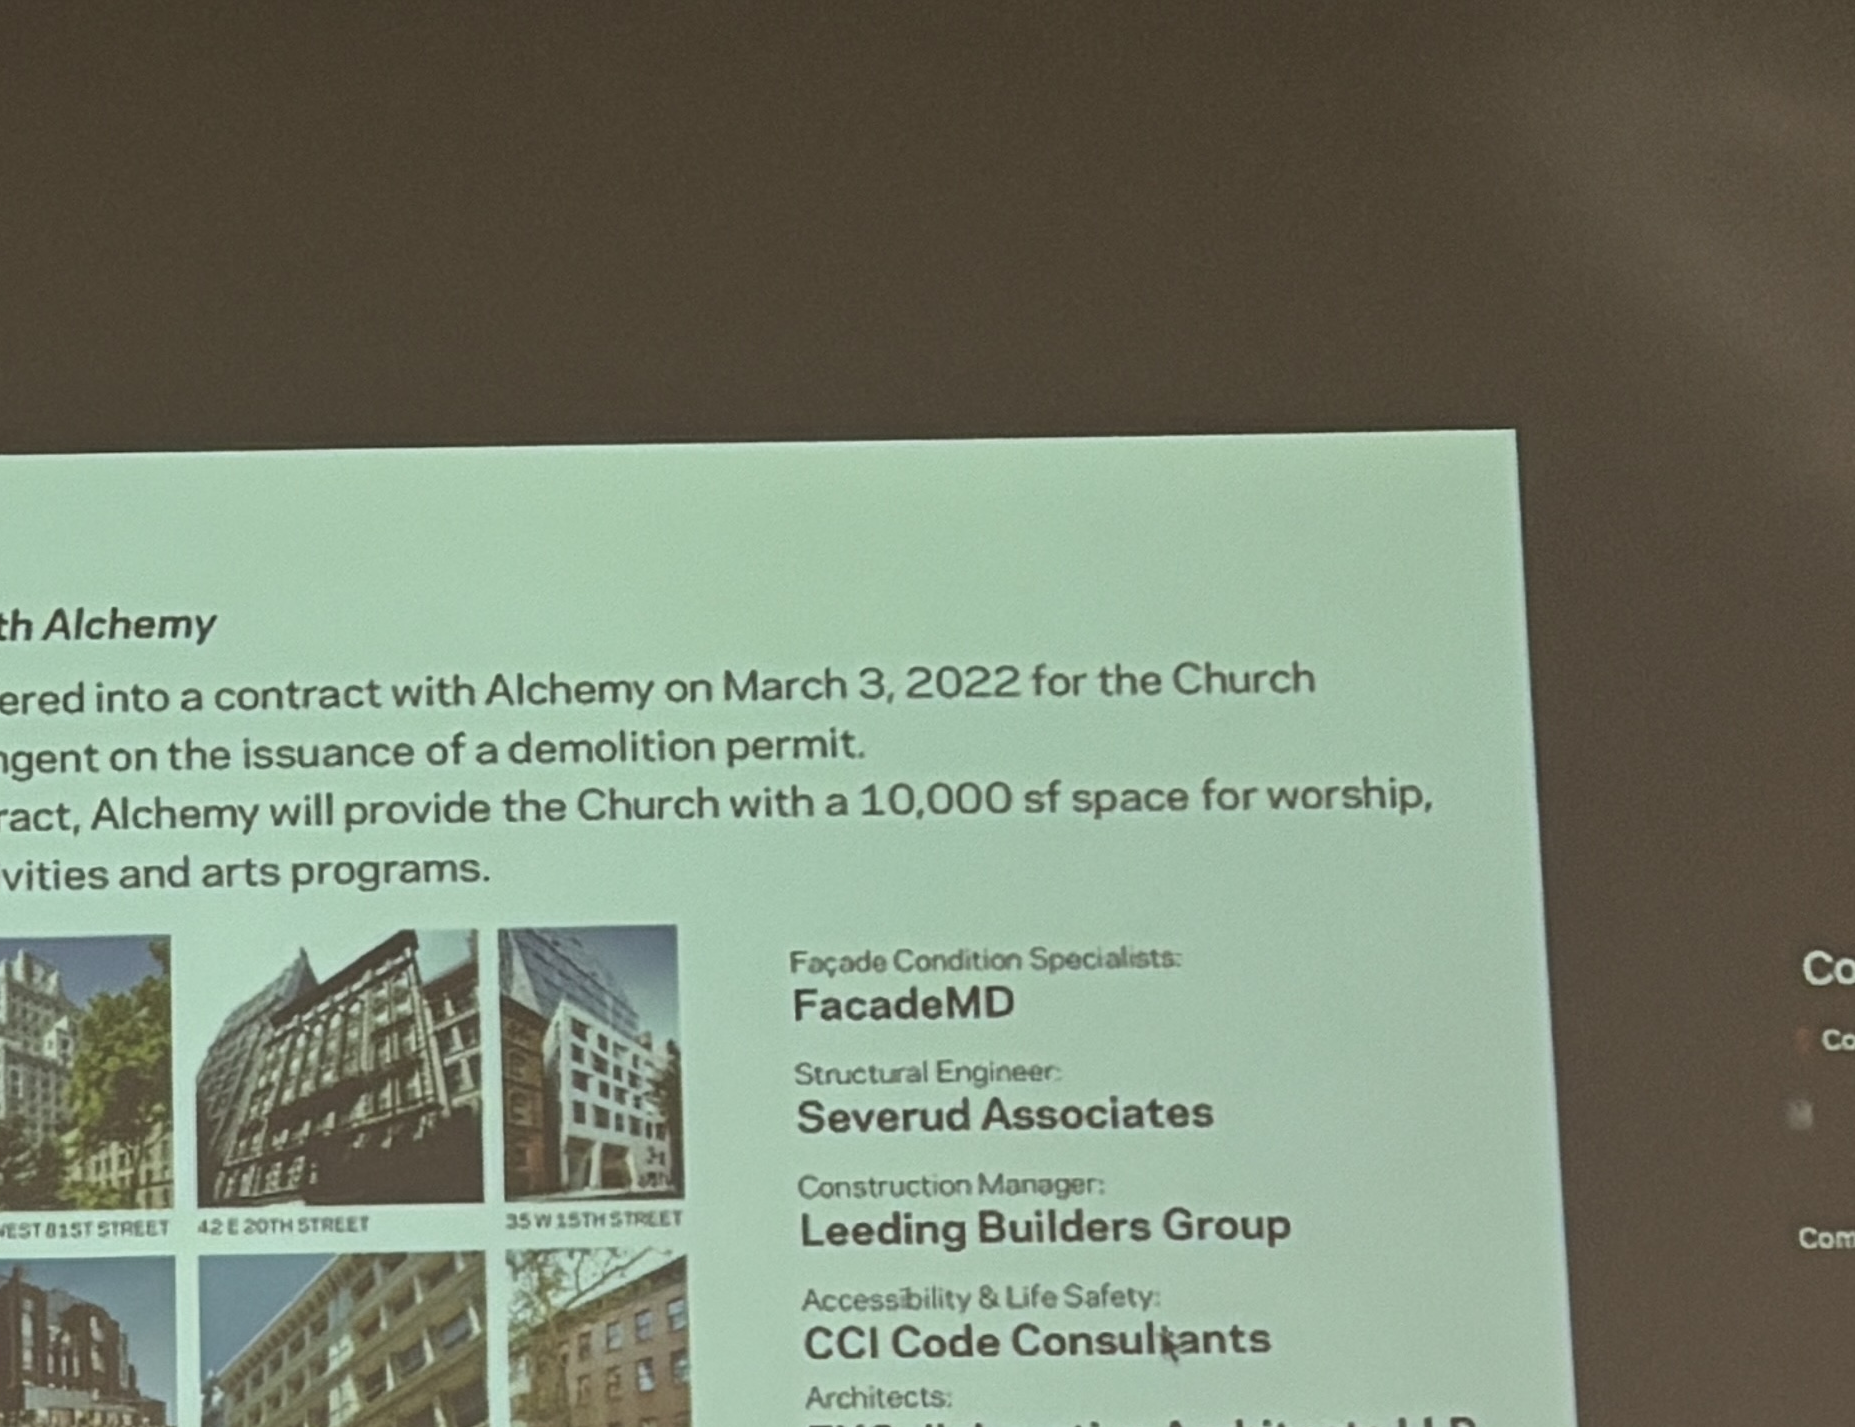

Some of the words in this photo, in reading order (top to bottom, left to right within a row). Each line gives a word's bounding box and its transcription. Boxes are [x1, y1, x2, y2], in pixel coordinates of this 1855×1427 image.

[40, 606, 218, 643] Alchemy
[95, 681, 171, 714] into
[180, 687, 204, 713] a
[214, 678, 383, 712] contract
[391, 673, 477, 708] with
[484, 671, 655, 711] Alchemy
[664, 678, 714, 704] on
[723, 666, 848, 702] March
[859, 666, 895, 705] 3,
[905, 664, 1022, 700] 2022
[1030, 662, 1088, 698] for
[1097, 662, 1162, 697] the
[1172, 660, 1316, 696] Church
[108, 747, 158, 773] on
[167, 736, 232, 771] the
[242, 737, 415, 770] issuance
[425, 730, 467, 767] of
[475, 741, 499, 766] a
[507, 728, 716, 765] demolition
[726, 726, 866, 767] permit.
[90, 795, 260, 836] Alchemy
[269, 791, 334, 827] will
[344, 789, 491, 834] provide
[501, 788, 567, 823] the
[576, 785, 720, 822] Church
[729, 784, 815, 819] with
[825, 793, 849, 817] a
[860, 781, 1013, 820] 10,000
[1023, 780, 1062, 814] sf
[1072, 787, 1190, 820] space
[1201, 777, 1259, 811] for
[1266, 775, 1433, 818] worship,
[118, 855, 191, 890] and
[201, 857, 282, 889] arts
[291, 859, 490, 894] programs.
[789, 948, 888, 979] Façade
[892, 948, 1023, 974] Condition
[793, 984, 1015, 1022] FacadeMD
[793, 1059, 929, 1086] Structural
[797, 1096, 971, 1134] Severud
[980, 1094, 1215, 1131] Associates
[797, 1173, 973, 1201] Construction
[977, 1172, 1106, 1201] Manager:
[97, 1219, 170, 1239] STREET
[197, 1217, 224, 1236] 42
[226, 1217, 239, 1236] E
[242, 1217, 294, 1236] 20TH
[297, 1215, 370, 1235] STREET
[534, 1213, 553, 1229] W
[556, 1211, 606, 1229] 15TH
[609, 1209, 682, 1228] STREET
[801, 1210, 967, 1251] Leeding
[977, 1207, 1152, 1244] Builders
[1162, 1206, 1292, 1247] Group
[800, 1285, 972, 1314] Accessibility
[978, 1283, 1001, 1311] &
[1005, 1282, 1059, 1310] Life
[1062, 1281, 1161, 1312] Safety:
[804, 1324, 879, 1360] CCI
[891, 1322, 1001, 1359] Code
[804, 1384, 953, 1411] Architects:
